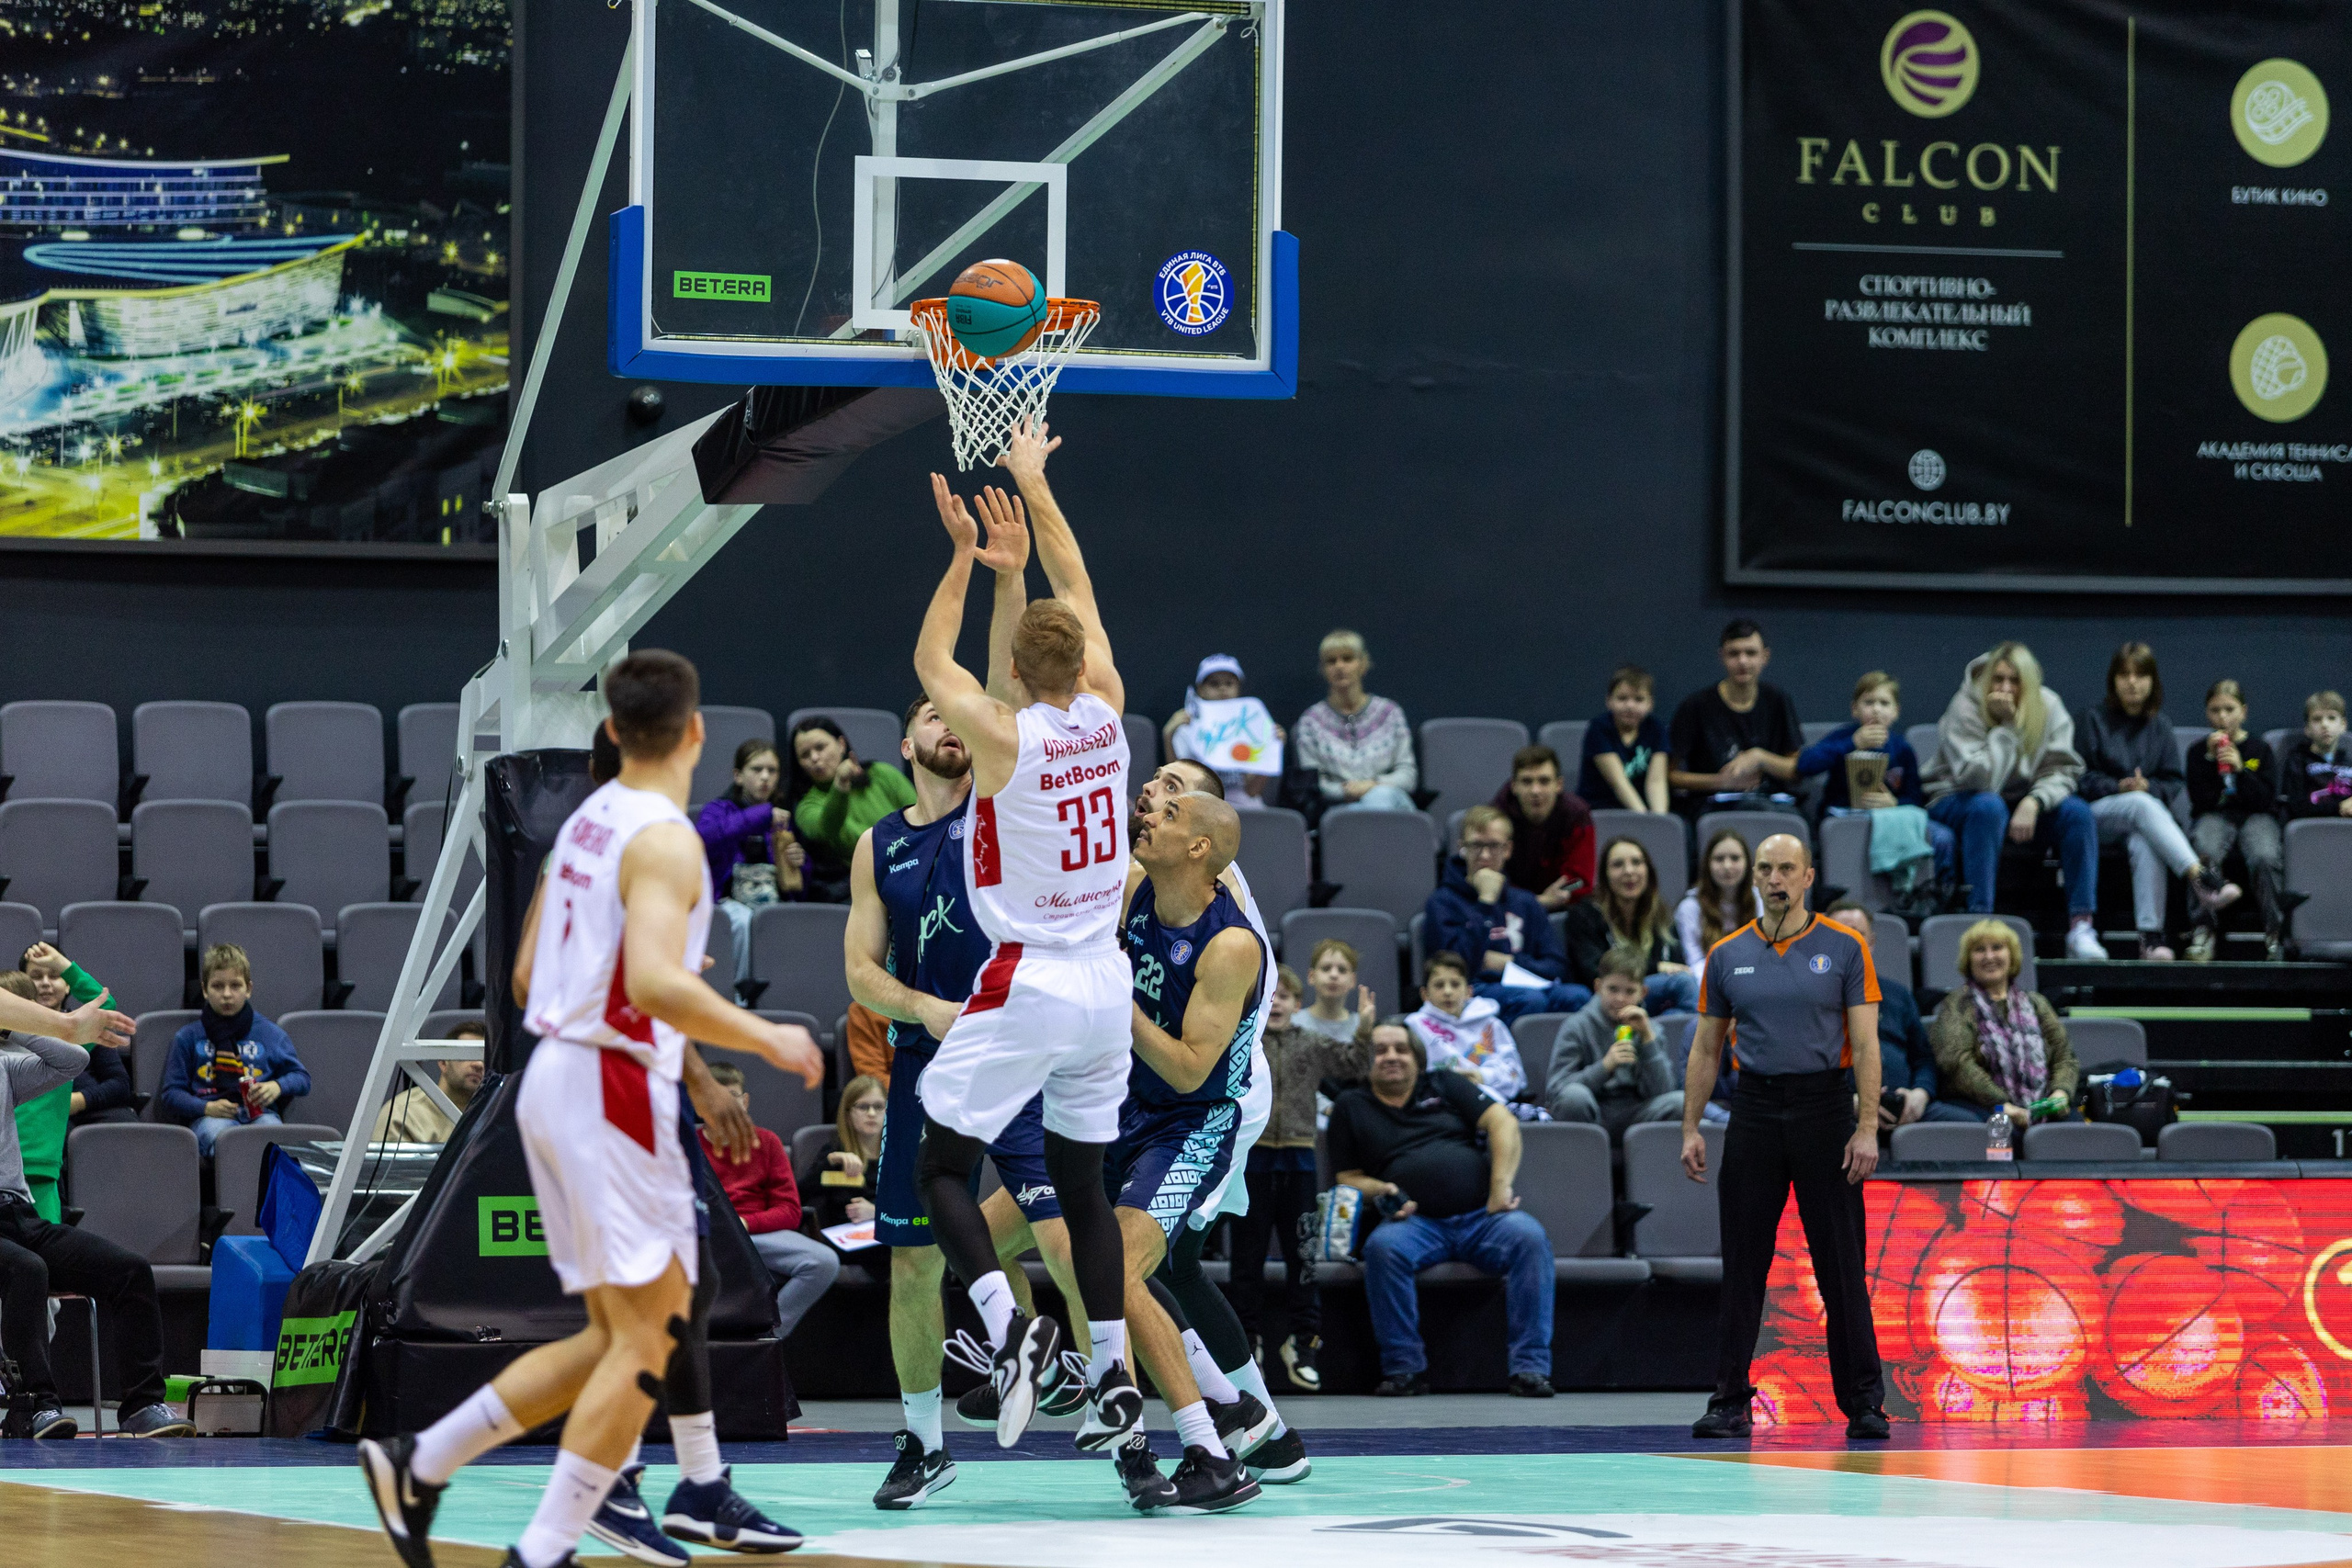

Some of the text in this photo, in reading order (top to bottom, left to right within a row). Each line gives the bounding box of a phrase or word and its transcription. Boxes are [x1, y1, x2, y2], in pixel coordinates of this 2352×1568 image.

[1796, 137, 2062, 193] FALCON
[2231, 186, 2329, 207] БУТИК КИНО
[1861, 202, 1996, 227] CLUB
[1159, 252, 1227, 279] ЕДИНАЯ ЛИГА ВТБ
[1859, 275, 1998, 299] СПОРТИВНО-
[1160, 307, 1229, 335] VTB UNITED LEAGUE
[1825, 299, 2032, 326] РАЗВЛЕКАТЕЛЬНЫЙ
[1868, 326, 1990, 351] КОМПЛЕКС
[2196, 441, 2287, 461] АКАДЕМИЯ
[2233, 462, 2324, 482] И СКВОША
[1842, 499, 2011, 525] FALCONCLUB.BY
[1040, 760, 1120, 791] BetBoom
[1057, 786, 1116, 872] 33
[888, 858, 919, 874] Kempa
[1134, 953, 1165, 1001] 22
[880, 1212, 909, 1227] Kempa
